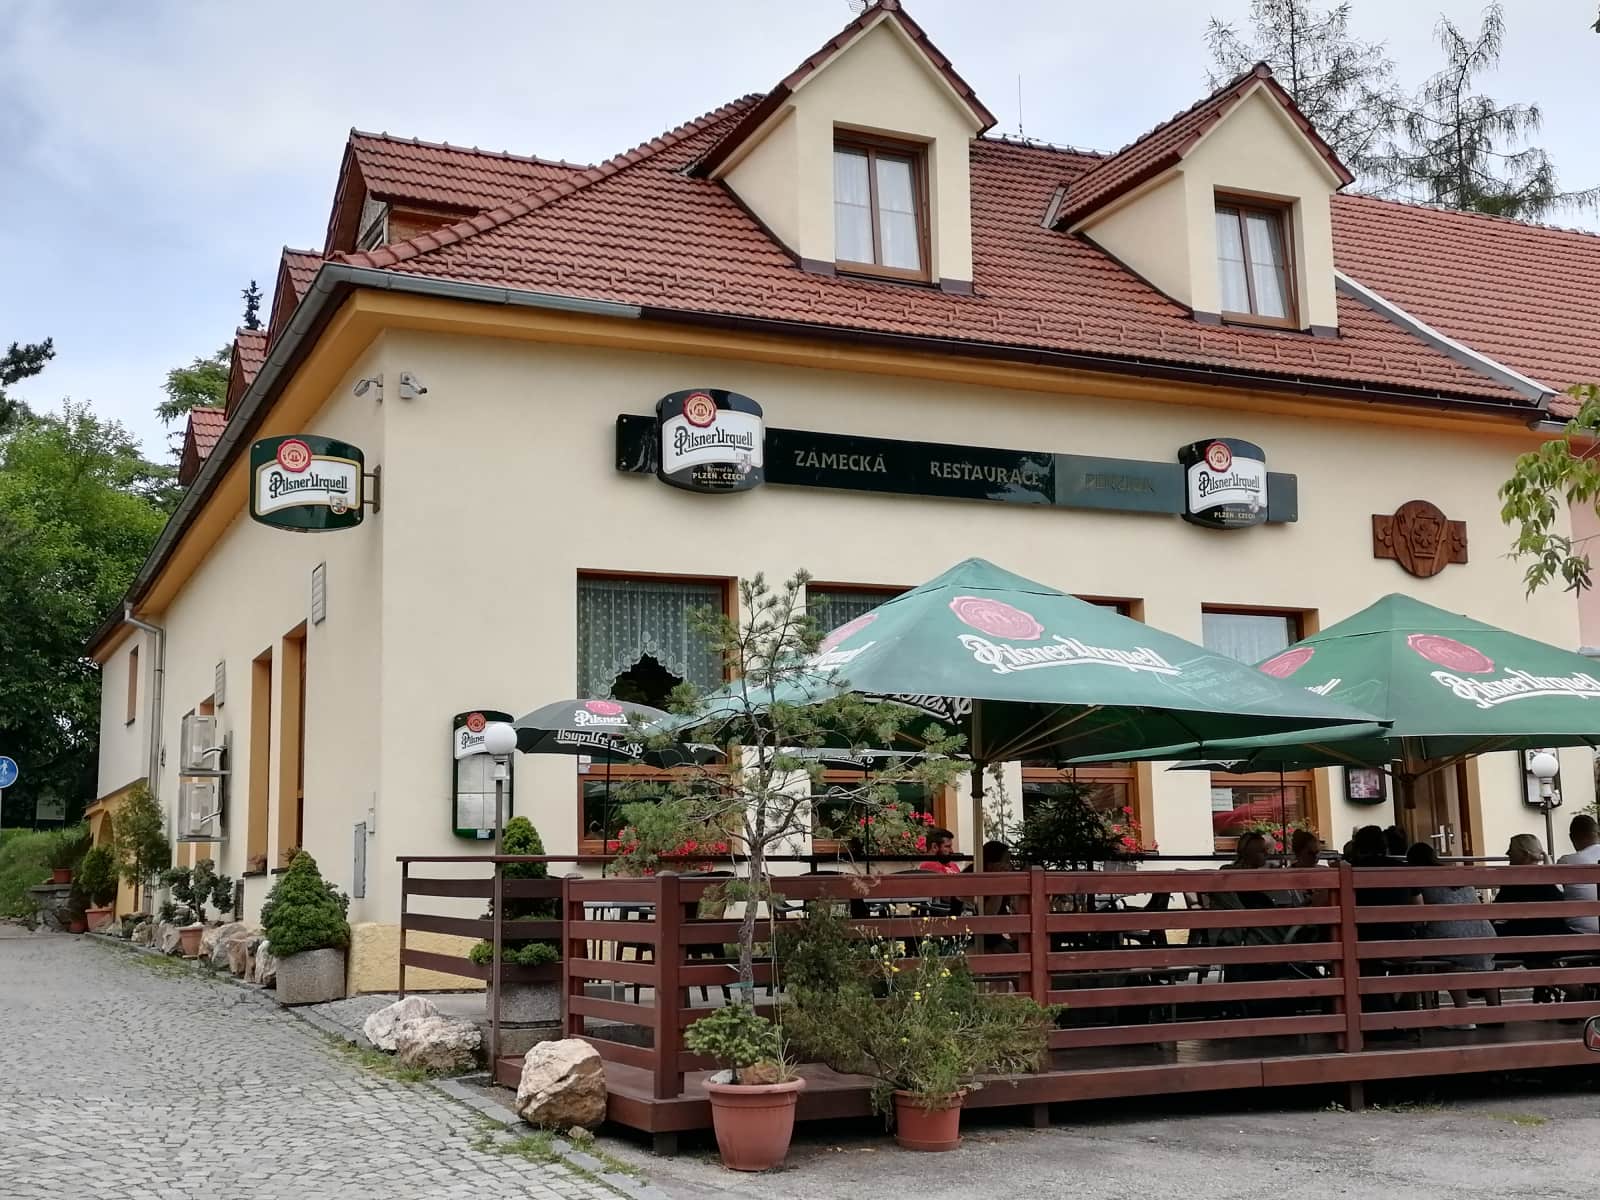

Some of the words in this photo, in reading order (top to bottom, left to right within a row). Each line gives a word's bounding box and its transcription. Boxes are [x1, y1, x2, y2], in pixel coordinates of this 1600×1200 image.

[674, 426, 717, 456] Pilsner
[715, 427, 752, 451] Urquell
[722, 472, 746, 481] CZECH
[794, 447, 887, 473] ZÁMECKÁ
[930, 460, 1040, 486] RESTAURACE
[269, 471, 310, 498] Pilsner
[309, 472, 347, 494] Urquell
[1199, 471, 1233, 497] Pilsner
[1231, 472, 1260, 493] Urquell
[957, 634, 1074, 674] Pilsner
[1052, 634, 1172, 672] Urquell
[1430, 671, 1527, 708] Pilsner
[574, 710, 622, 727] Pilsner
